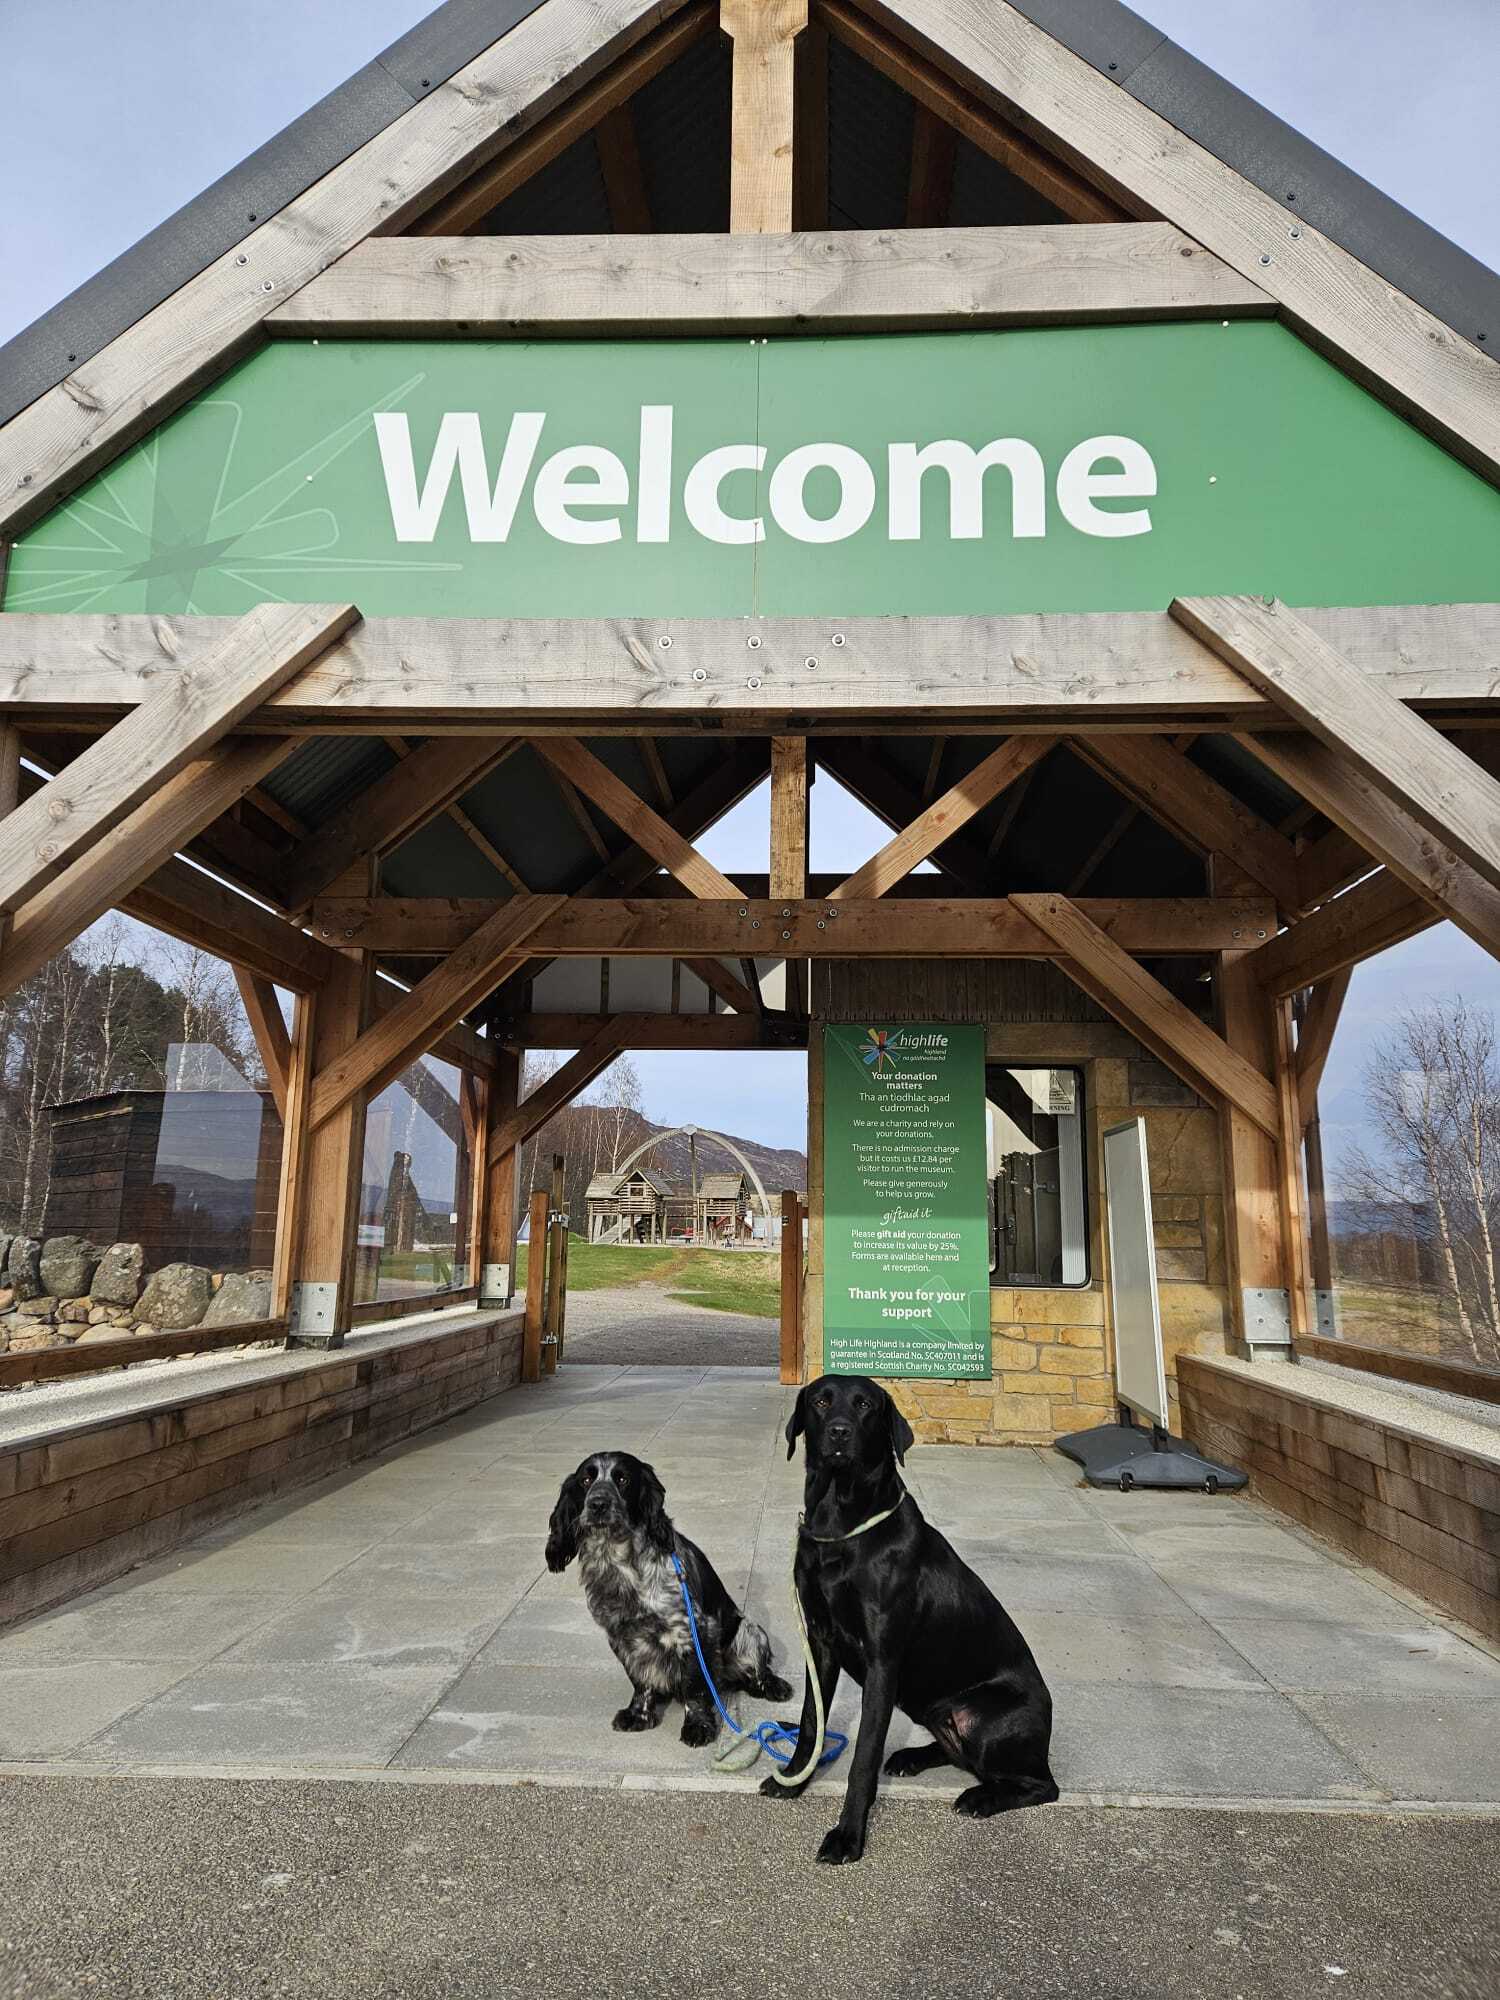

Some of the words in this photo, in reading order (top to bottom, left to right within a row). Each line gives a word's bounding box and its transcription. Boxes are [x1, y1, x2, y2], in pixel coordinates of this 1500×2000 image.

[373, 405, 1158, 545] Welcome
[872, 1072, 892, 1080] Your
[895, 1072, 937, 1080] donation
[860, 1093, 875, 1101] Tha
[928, 1093, 950, 1103] agad
[880, 1103, 929, 1112] cudromach
[886, 1120, 911, 1128] charity
[934, 1146, 960, 1154] charge
[940, 1156, 952, 1165] per
[857, 1164, 880, 1172] visitor
[889, 1180, 904, 1189] give
[906, 1180, 948, 1189] generously
[886, 1190, 901, 1199] help
[915, 1192, 935, 1200] grow.
[851, 1229, 875, 1237] Please
[877, 1230, 890, 1239] gift
[893, 1230, 905, 1238] aid
[907, 1232, 924, 1240] your
[927, 1231, 960, 1239] donation
[864, 1241, 894, 1249] increase
[930, 1242, 938, 1251] by
[852, 1252, 875, 1260] Forms
[891, 1252, 923, 1260] available
[944, 1253, 959, 1261] and
[849, 1288, 887, 1299] Thank
[890, 1290, 912, 1302] you
[916, 1289, 934, 1300] for
[935, 1291, 966, 1303] your
[882, 1307, 932, 1319] support
[830, 1339, 847, 1349] High
[850, 1339, 862, 1347] Life
[864, 1339, 897, 1349] Highland
[899, 1340, 904, 1348] is
[912, 1341, 946, 1350] company
[948, 1341, 973, 1350] limited
[975, 1342, 984, 1351] by
[878, 1351, 909, 1359] Scotland
[925, 1352, 960, 1360] SC407011
[836, 1361, 873, 1370] registered
[875, 1362, 904, 1370] Scottish
[906, 1362, 931, 1371] Charity
[948, 1363, 984, 1371] SC042593
